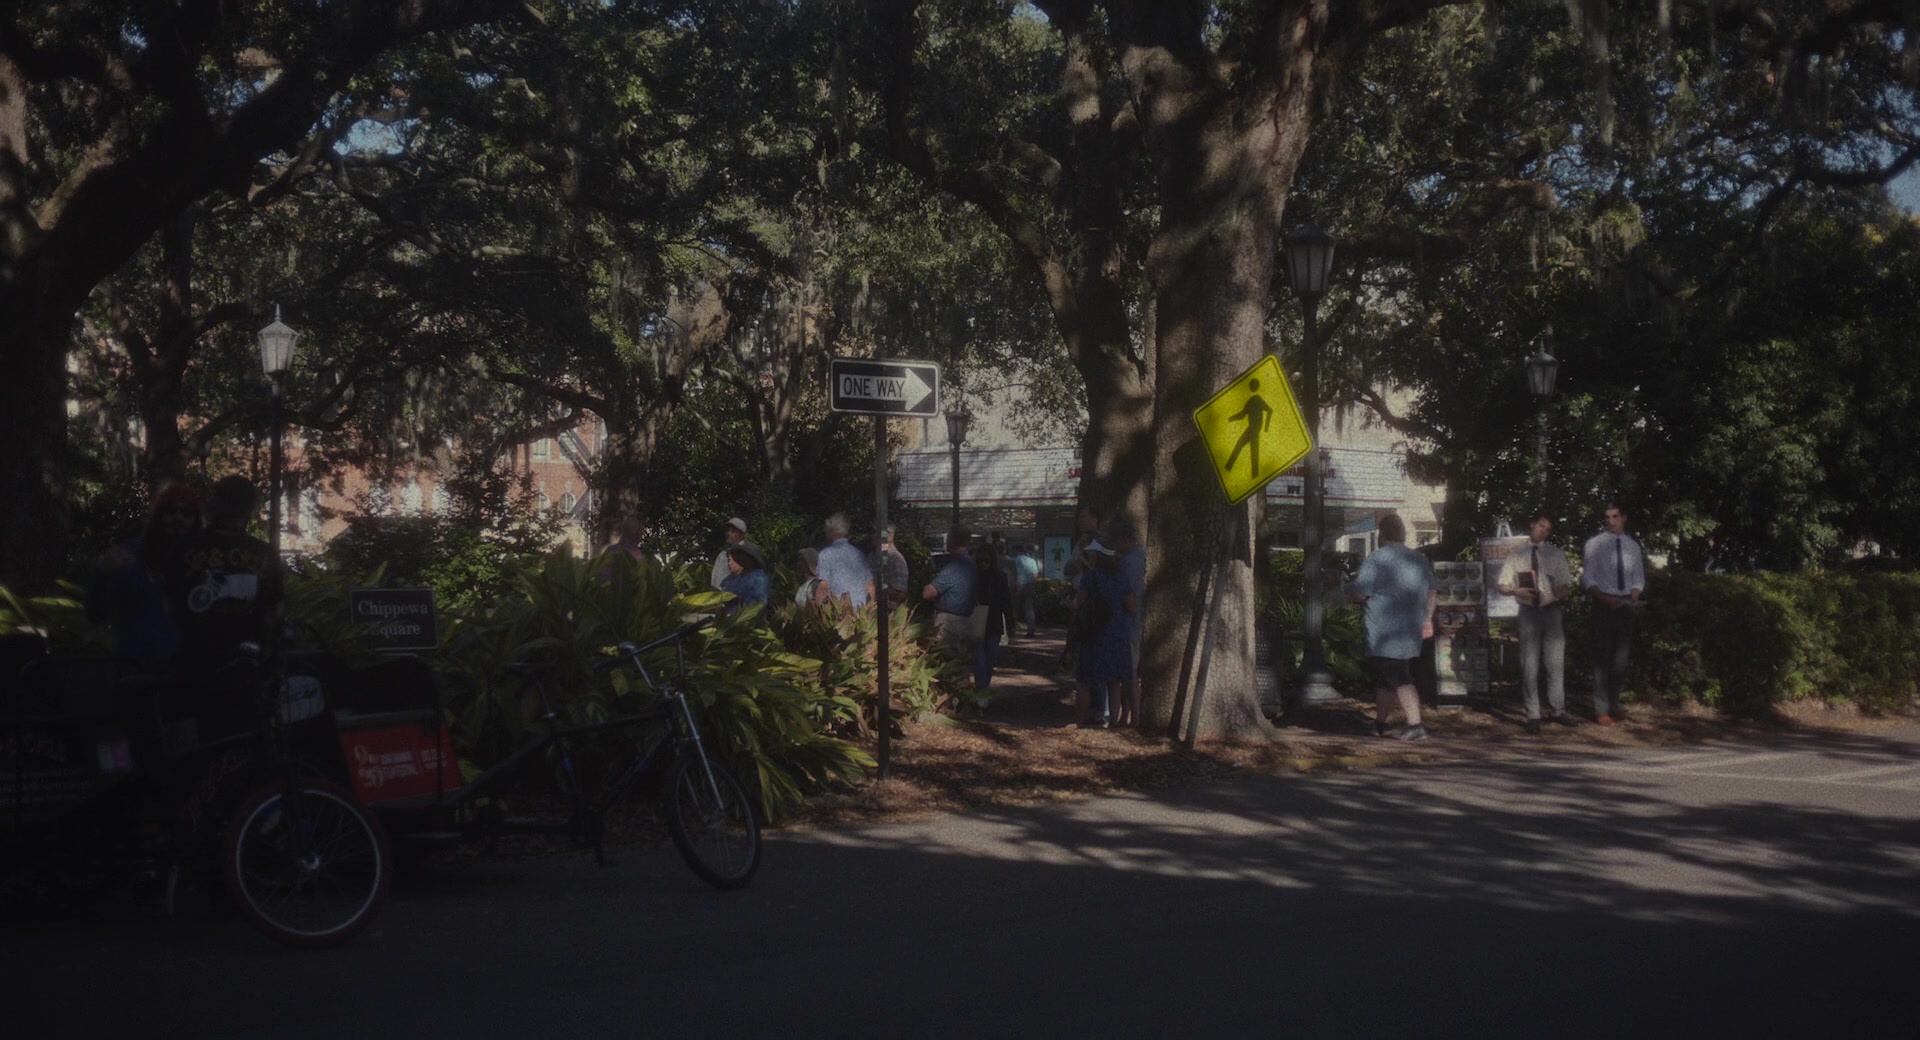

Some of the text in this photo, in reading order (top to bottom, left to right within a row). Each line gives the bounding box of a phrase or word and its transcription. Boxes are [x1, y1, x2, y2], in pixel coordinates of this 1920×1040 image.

[843, 376, 905, 399] ONE WAY
[357, 599, 429, 618] Chippewa
[375, 622, 421, 640] quare
